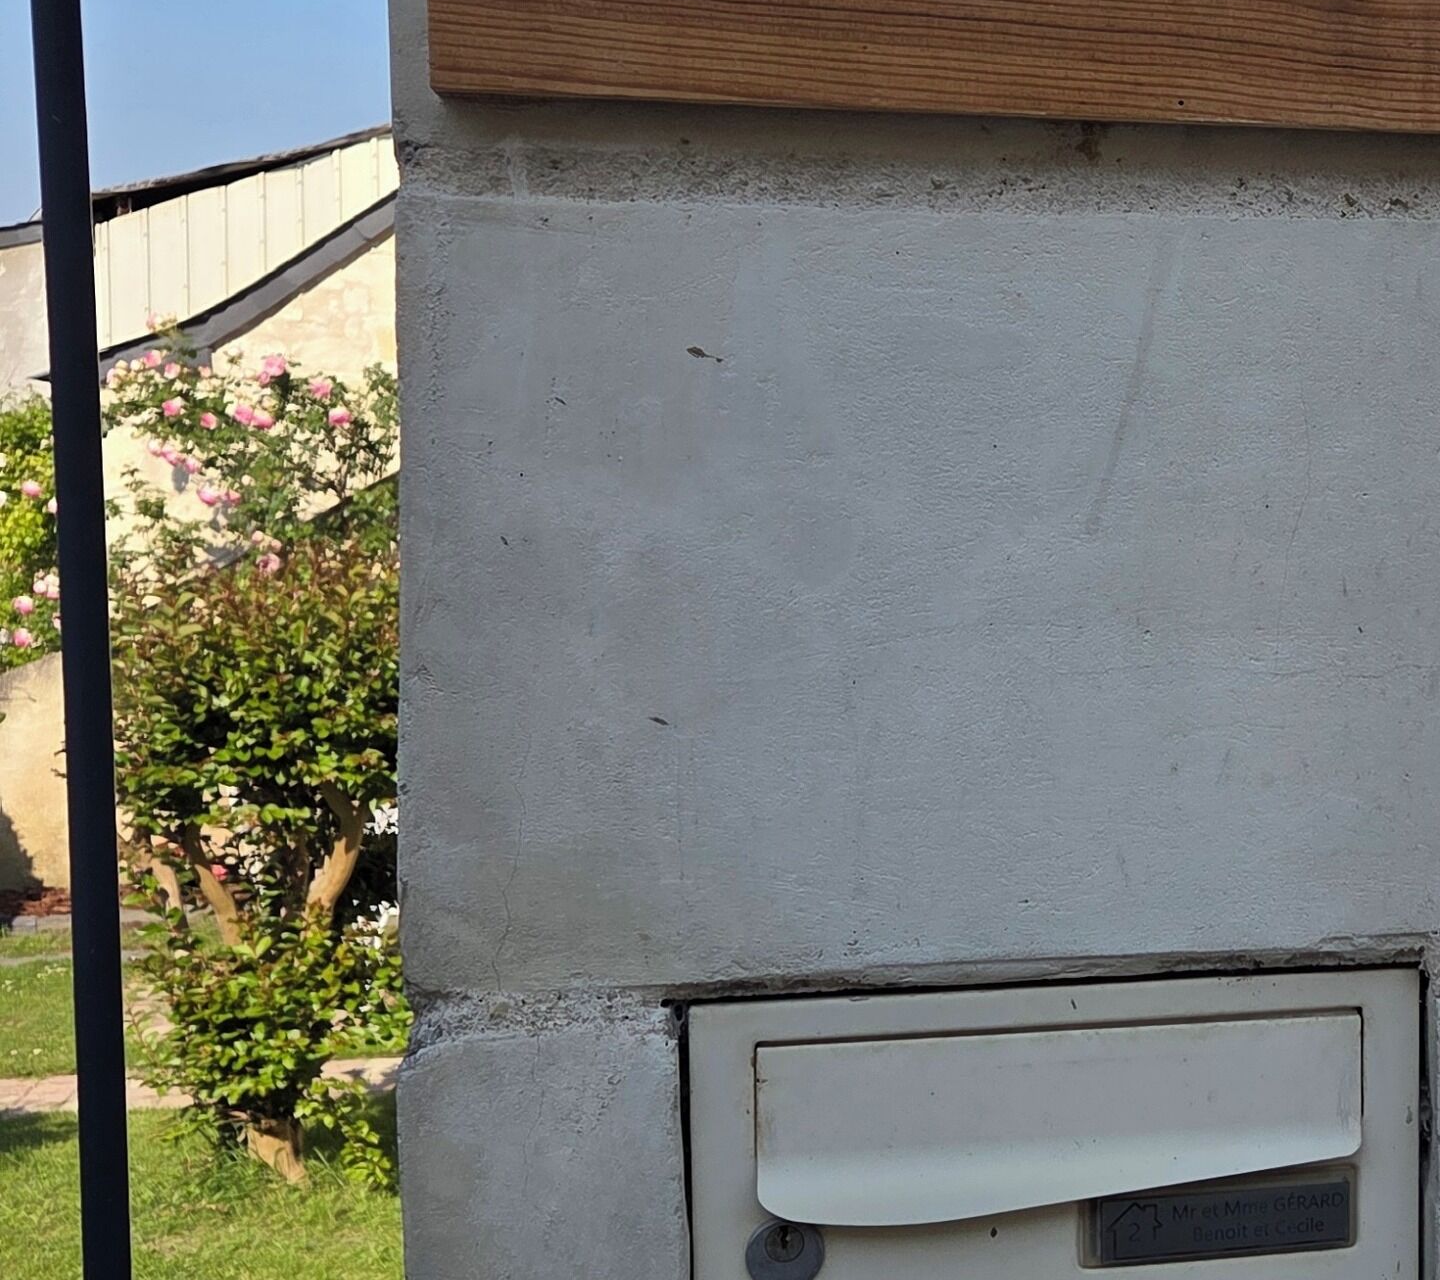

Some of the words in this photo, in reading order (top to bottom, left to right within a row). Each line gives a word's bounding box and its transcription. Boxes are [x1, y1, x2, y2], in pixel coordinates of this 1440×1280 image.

[1171, 1204, 1197, 1221] Mr
[1201, 1204, 1219, 1219] et
[1273, 1191, 1344, 1213] GÉRARD
